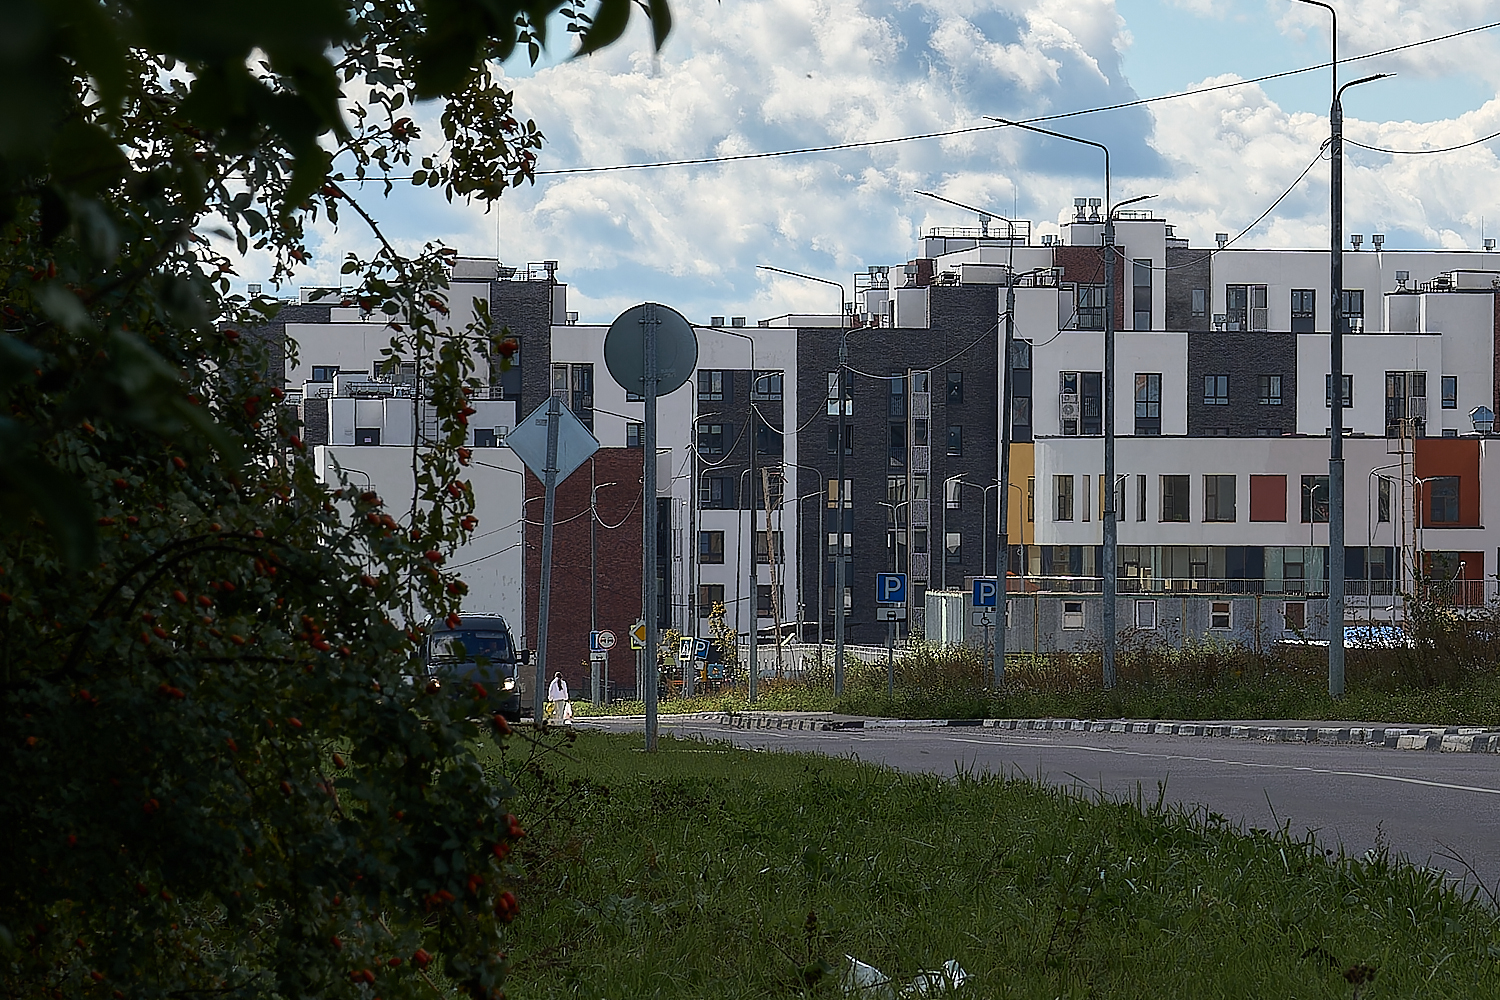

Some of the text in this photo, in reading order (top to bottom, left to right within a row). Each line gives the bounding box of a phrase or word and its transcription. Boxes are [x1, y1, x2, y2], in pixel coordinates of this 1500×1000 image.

[884, 576, 902, 600] P
[980, 582, 996, 605] P
[694, 641, 706, 655] P
